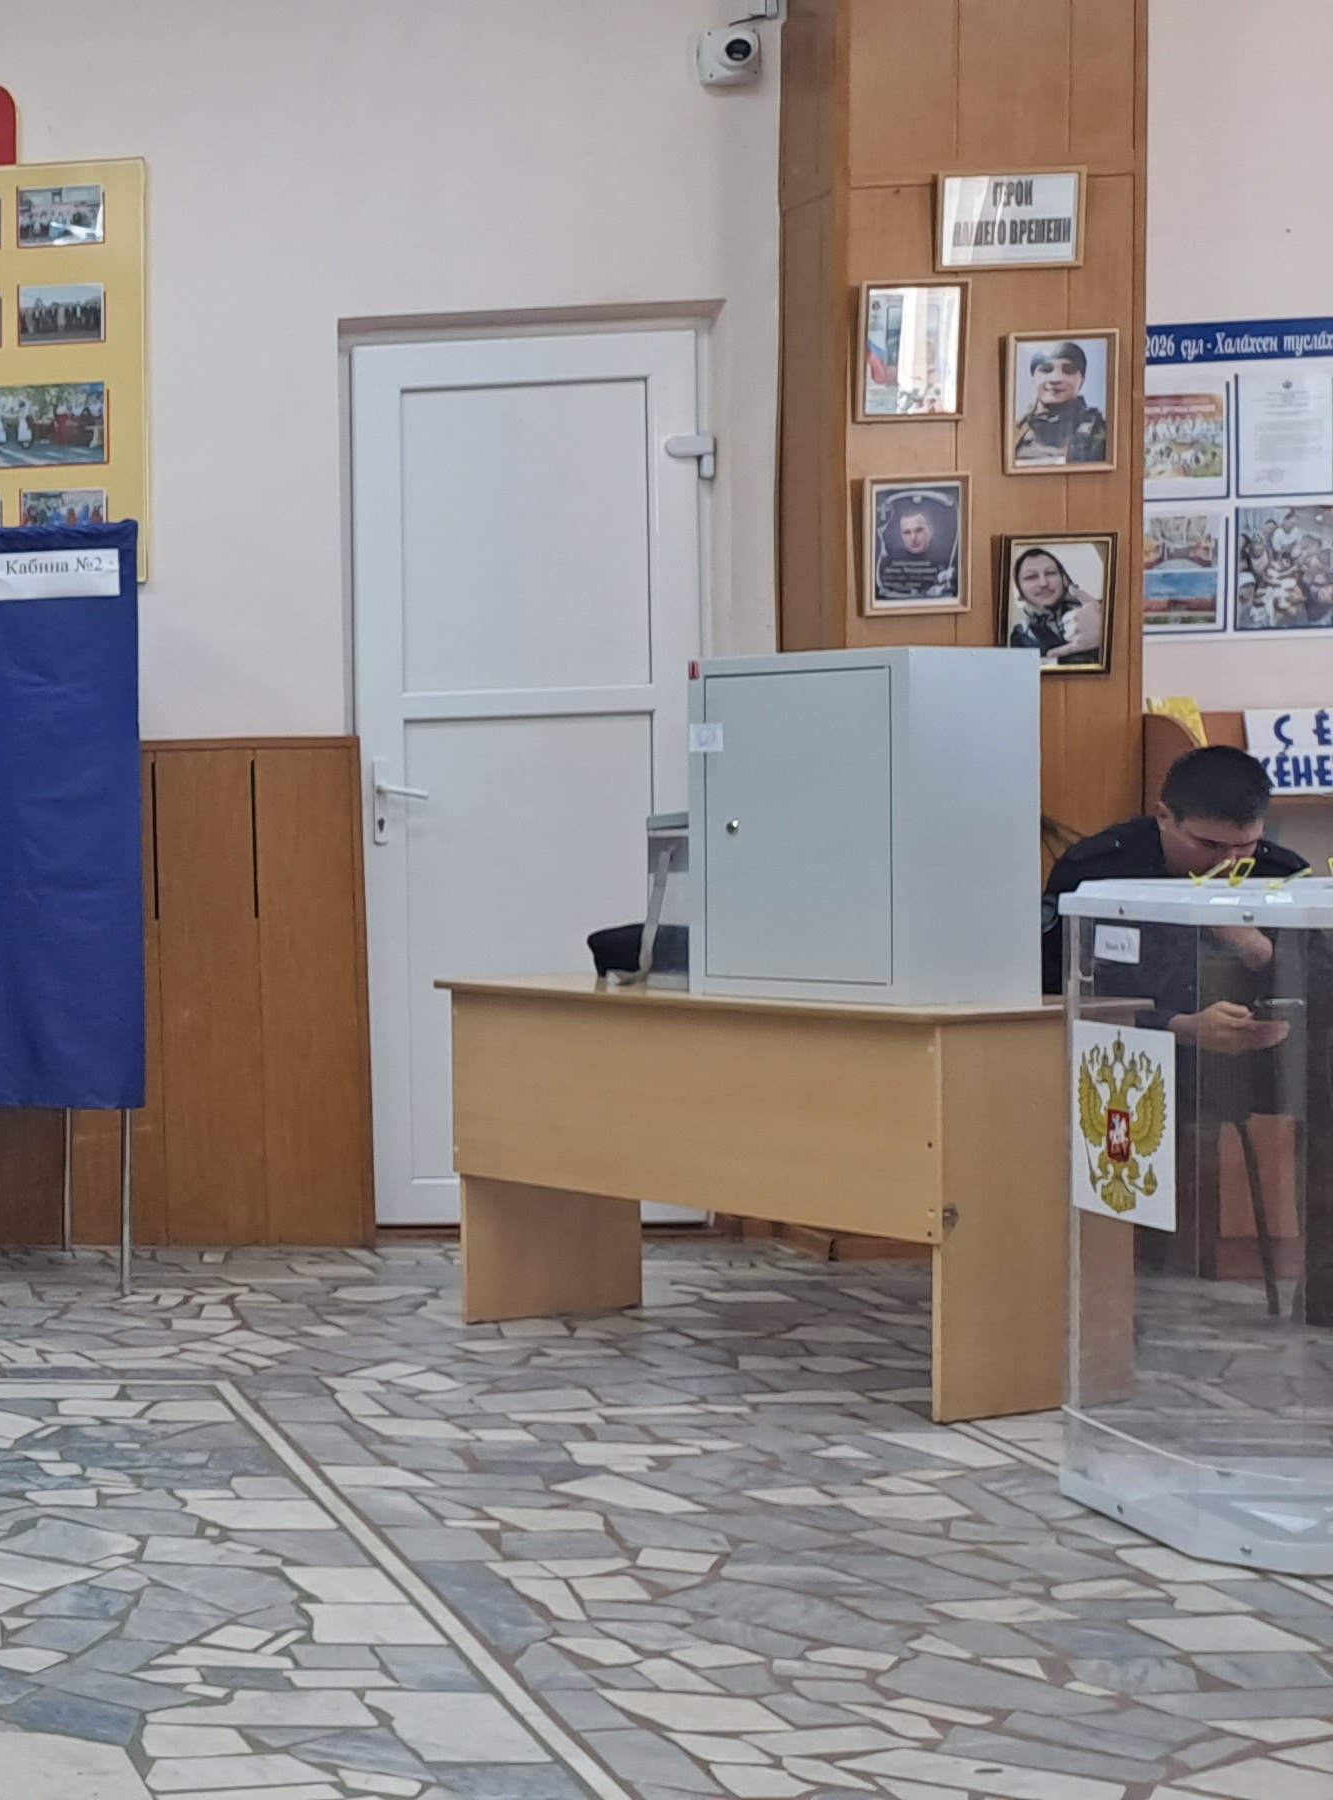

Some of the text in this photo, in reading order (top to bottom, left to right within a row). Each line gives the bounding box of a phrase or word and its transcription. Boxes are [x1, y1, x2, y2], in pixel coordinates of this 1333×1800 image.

[1009, 217, 1071, 245] ВРЕМЕНИ
[1145, 333, 1175, 358] 2026
[6, 556, 103, 575] Кабина №2
